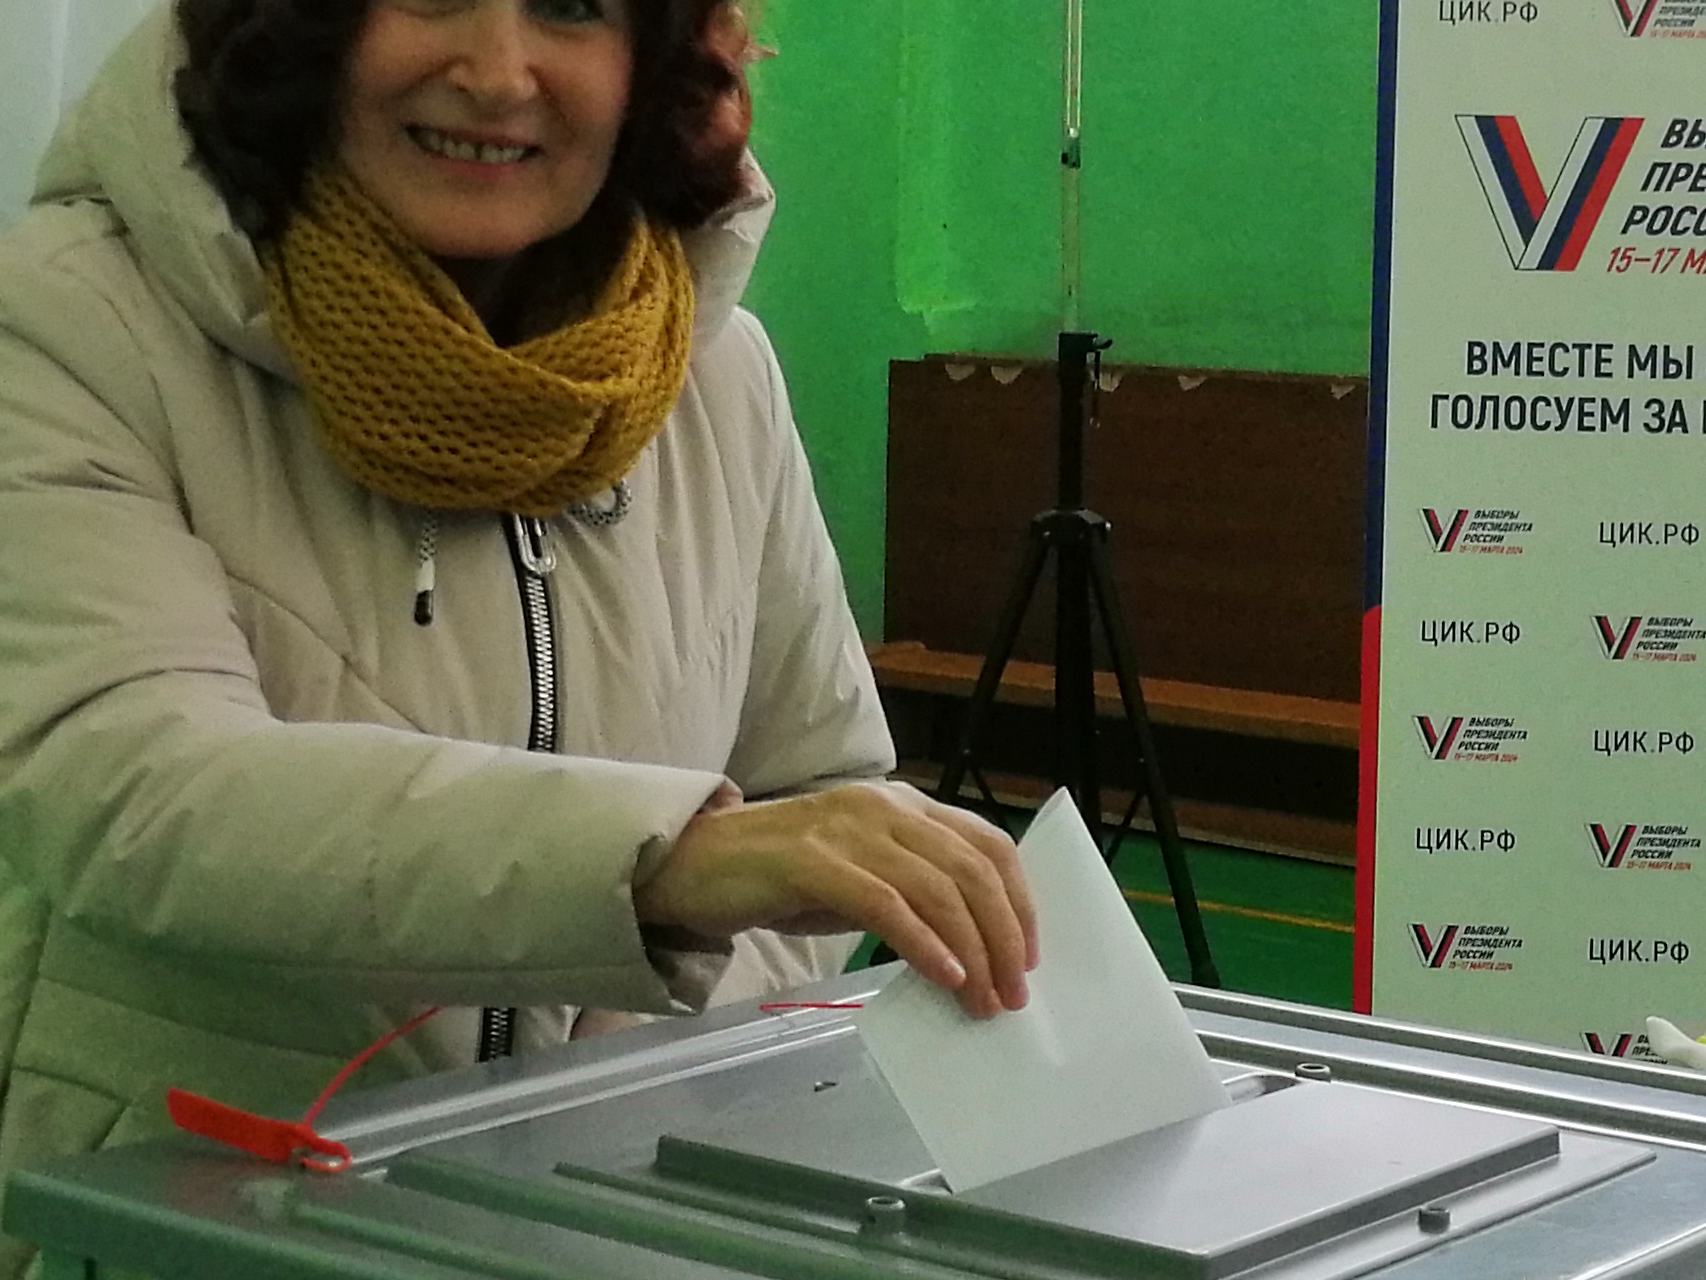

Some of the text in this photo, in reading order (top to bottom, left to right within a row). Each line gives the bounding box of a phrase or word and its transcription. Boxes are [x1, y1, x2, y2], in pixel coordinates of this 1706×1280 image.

[1439, 0, 1538, 26] ЦИК.РФ
[1466, 340, 1614, 379] ВМЕСТЕ
[1627, 344, 1694, 380] МЫ
[1430, 394, 1631, 433] ГОЛОСУЕМ
[1642, 397, 1690, 434] ЗА
[1463, 534, 1504, 543] РОССИИ
[1599, 521, 1700, 549] ЦИК.РФ
[1421, 620, 1521, 647] ЦИК.РФ
[1637, 642, 1678, 650] РОССИИ
[1458, 742, 1499, 750] РОССИИ
[1594, 729, 1694, 757] ЦИК.РФ
[1416, 827, 1516, 855] ЦИК.РФ
[1631, 850, 1673, 859] РОССИИ
[1453, 950, 1494, 959] РОССИИ
[1589, 938, 1689, 966] ЦИК.РФ
